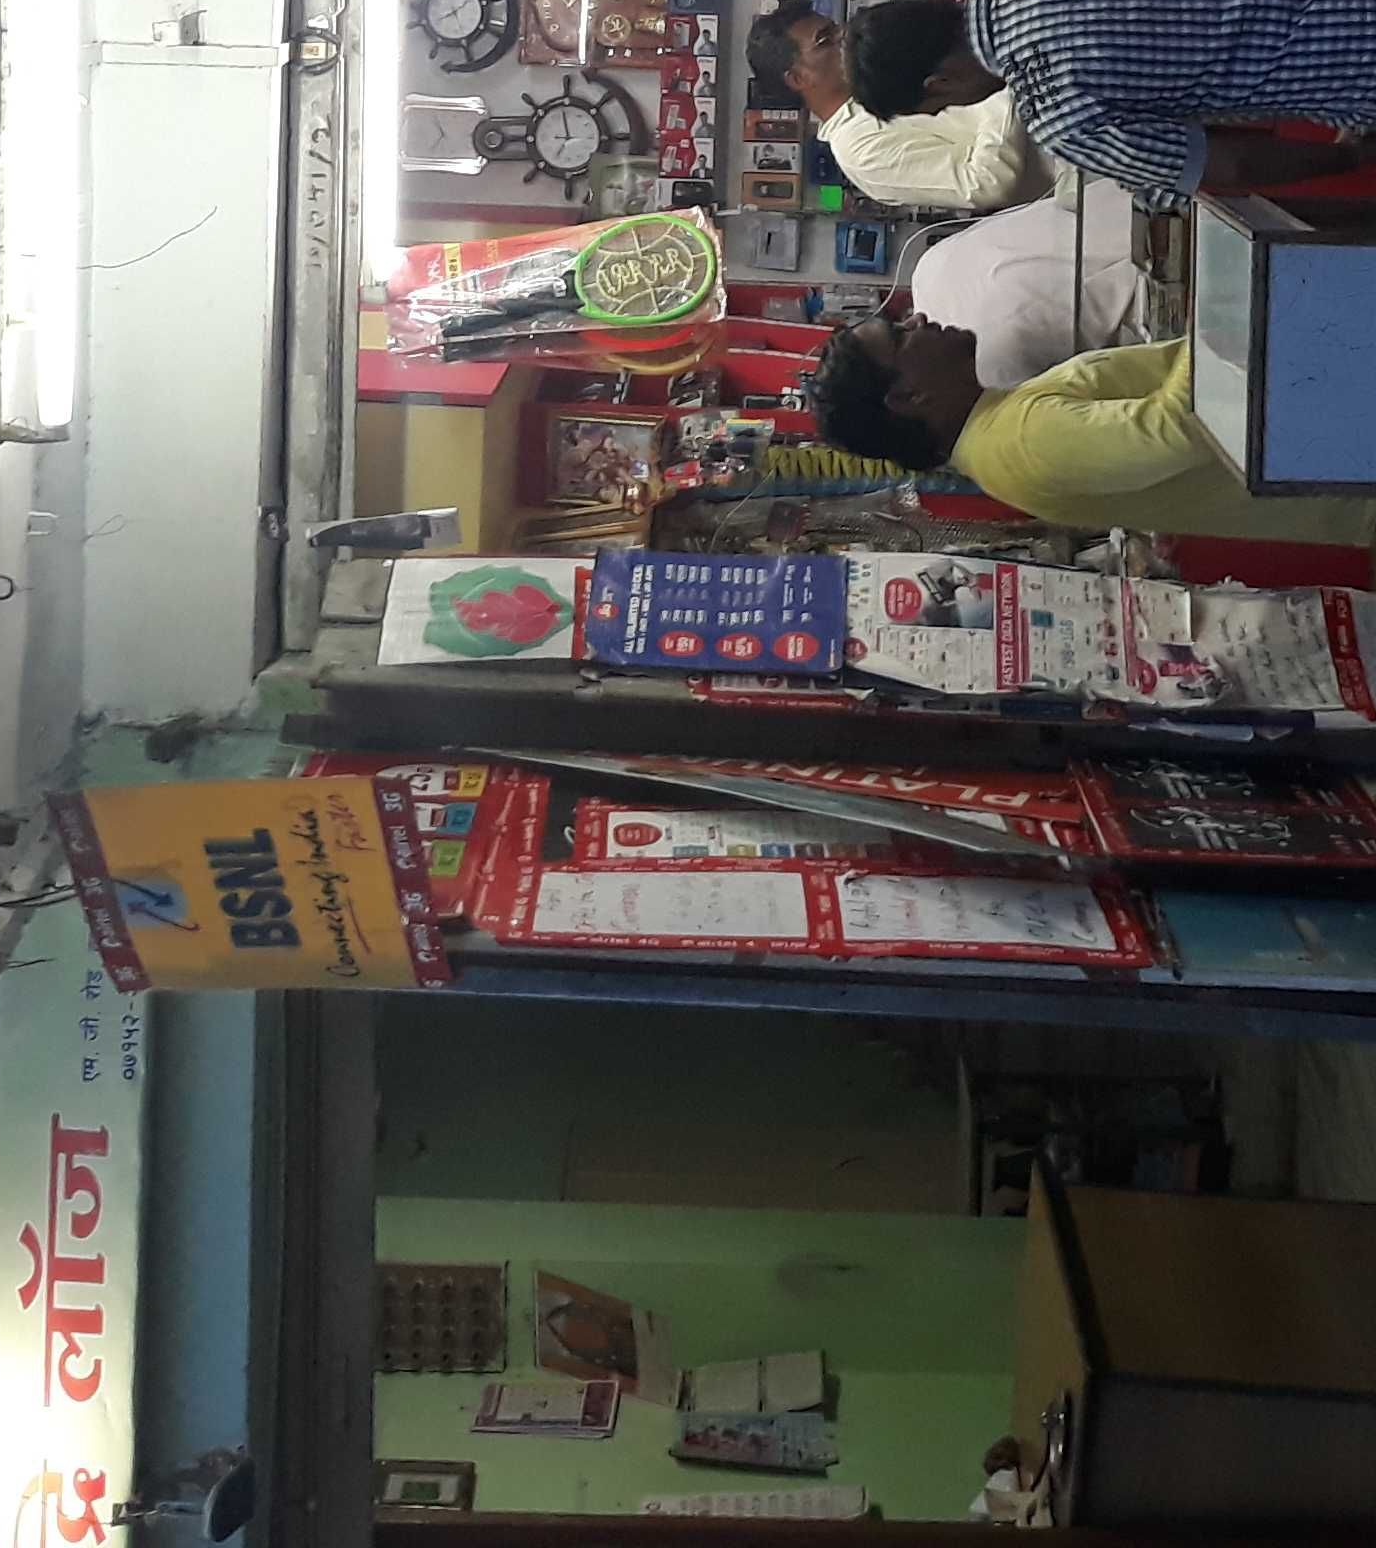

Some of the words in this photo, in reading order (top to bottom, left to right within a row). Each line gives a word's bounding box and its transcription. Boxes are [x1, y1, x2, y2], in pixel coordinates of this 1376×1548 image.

[1000, 641, 1015, 684] FASTEST
[382, 789, 402, 811] 3G
[291, 807, 330, 866] India
[80, 875, 104, 894] 3G
[202, 827, 303, 947] BSNL
[402, 890, 422, 909] 3G
[308, 869, 363, 977] Connecting
[77, 970, 101, 999] रोड
[119, 991, 140, 1080] ०७१५२-
[18, 1111, 110, 1406] लॉज
